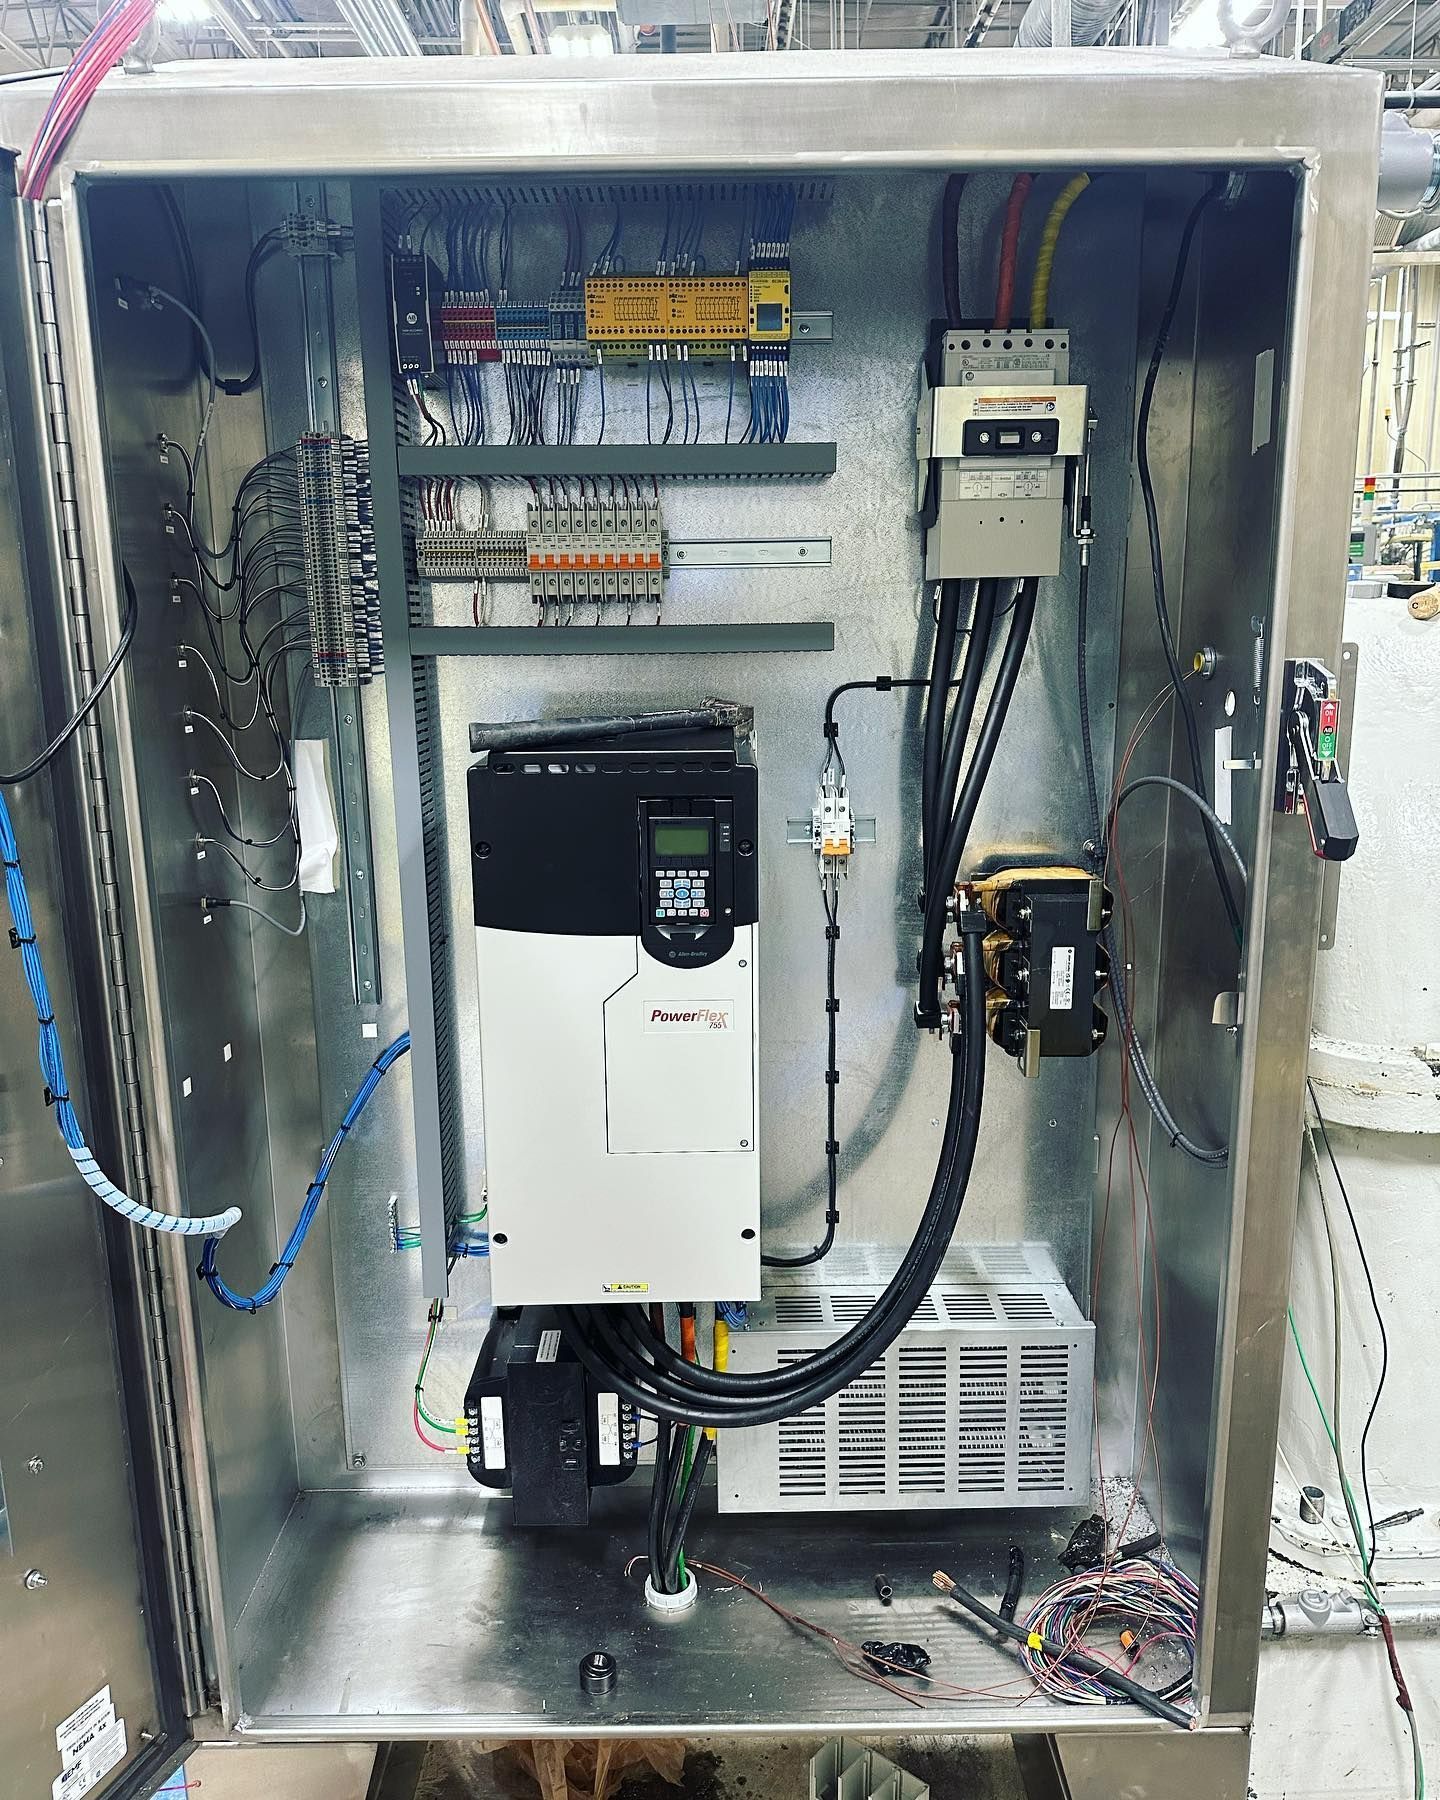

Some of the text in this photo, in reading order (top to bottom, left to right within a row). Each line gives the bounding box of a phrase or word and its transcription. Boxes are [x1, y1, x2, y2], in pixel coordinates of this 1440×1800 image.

[650, 1008, 729, 1029] PowerFlex
[709, 1021, 722, 1029] 755
[73, 1733, 95, 1756] NEMA
